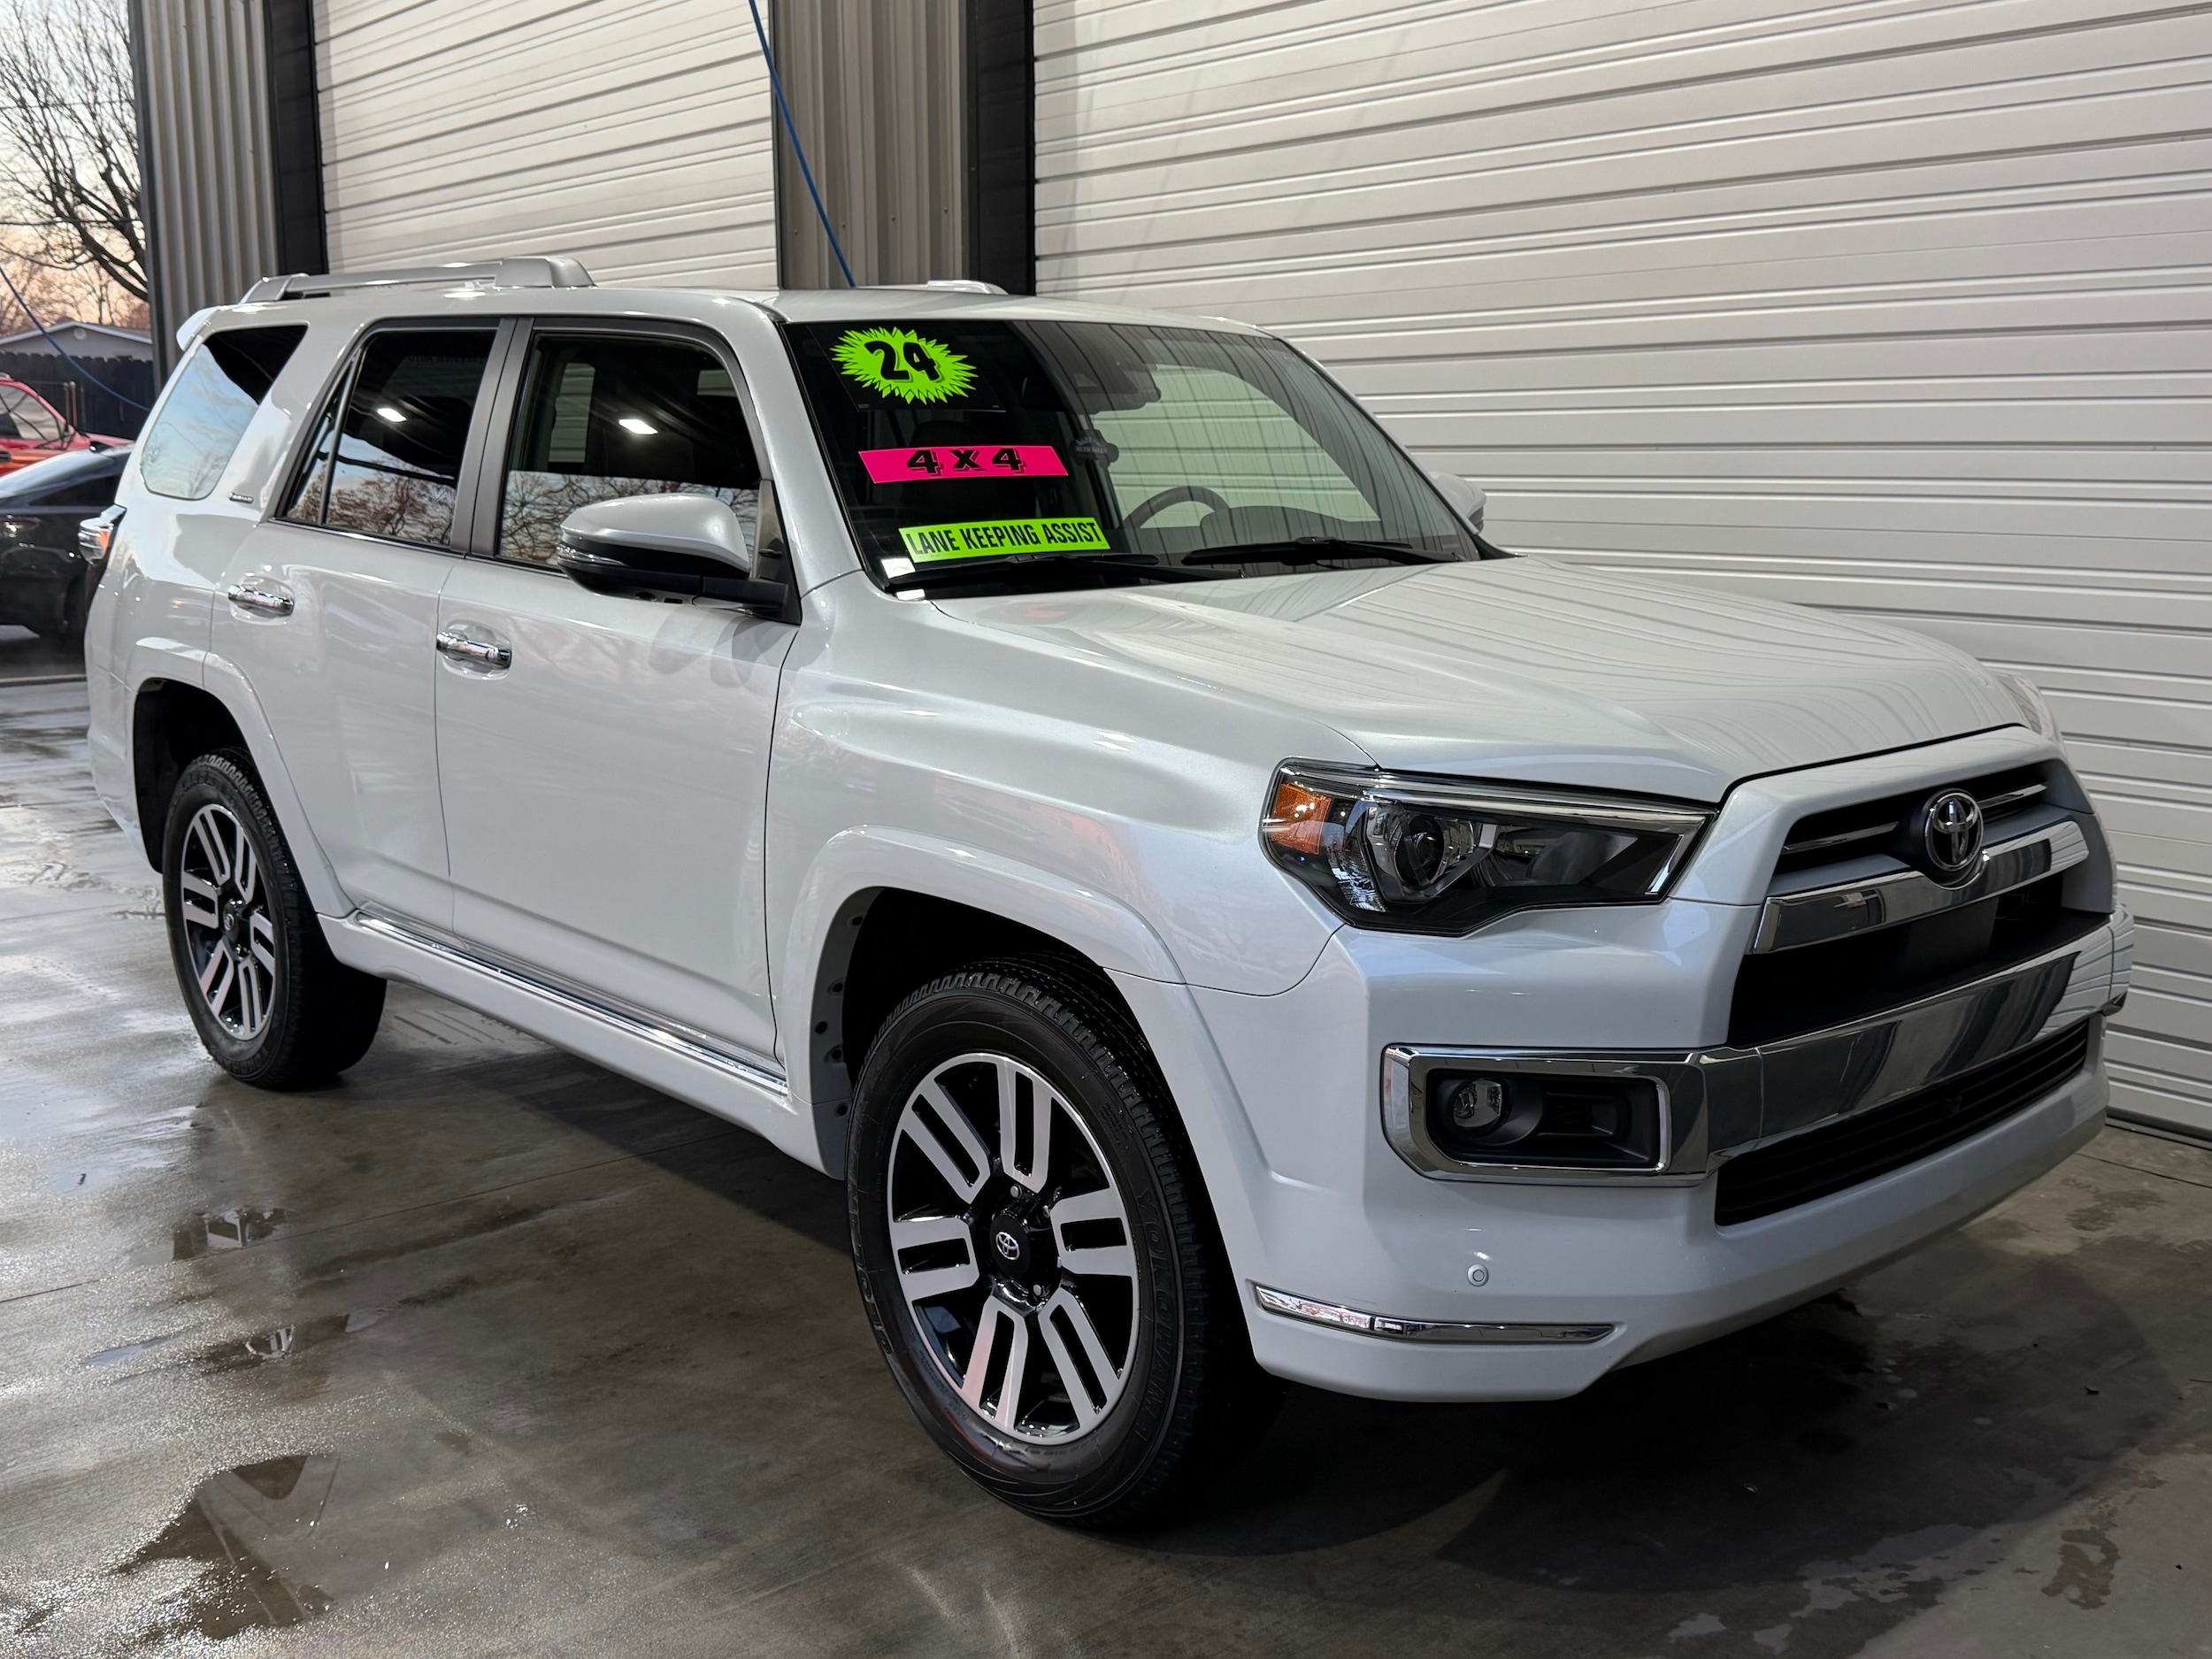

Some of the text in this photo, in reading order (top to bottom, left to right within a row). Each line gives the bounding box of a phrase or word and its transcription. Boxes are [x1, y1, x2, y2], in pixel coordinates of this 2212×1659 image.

[864, 341, 943, 382] 24
[906, 522, 1102, 555] LANE KEEPING ASSIST
